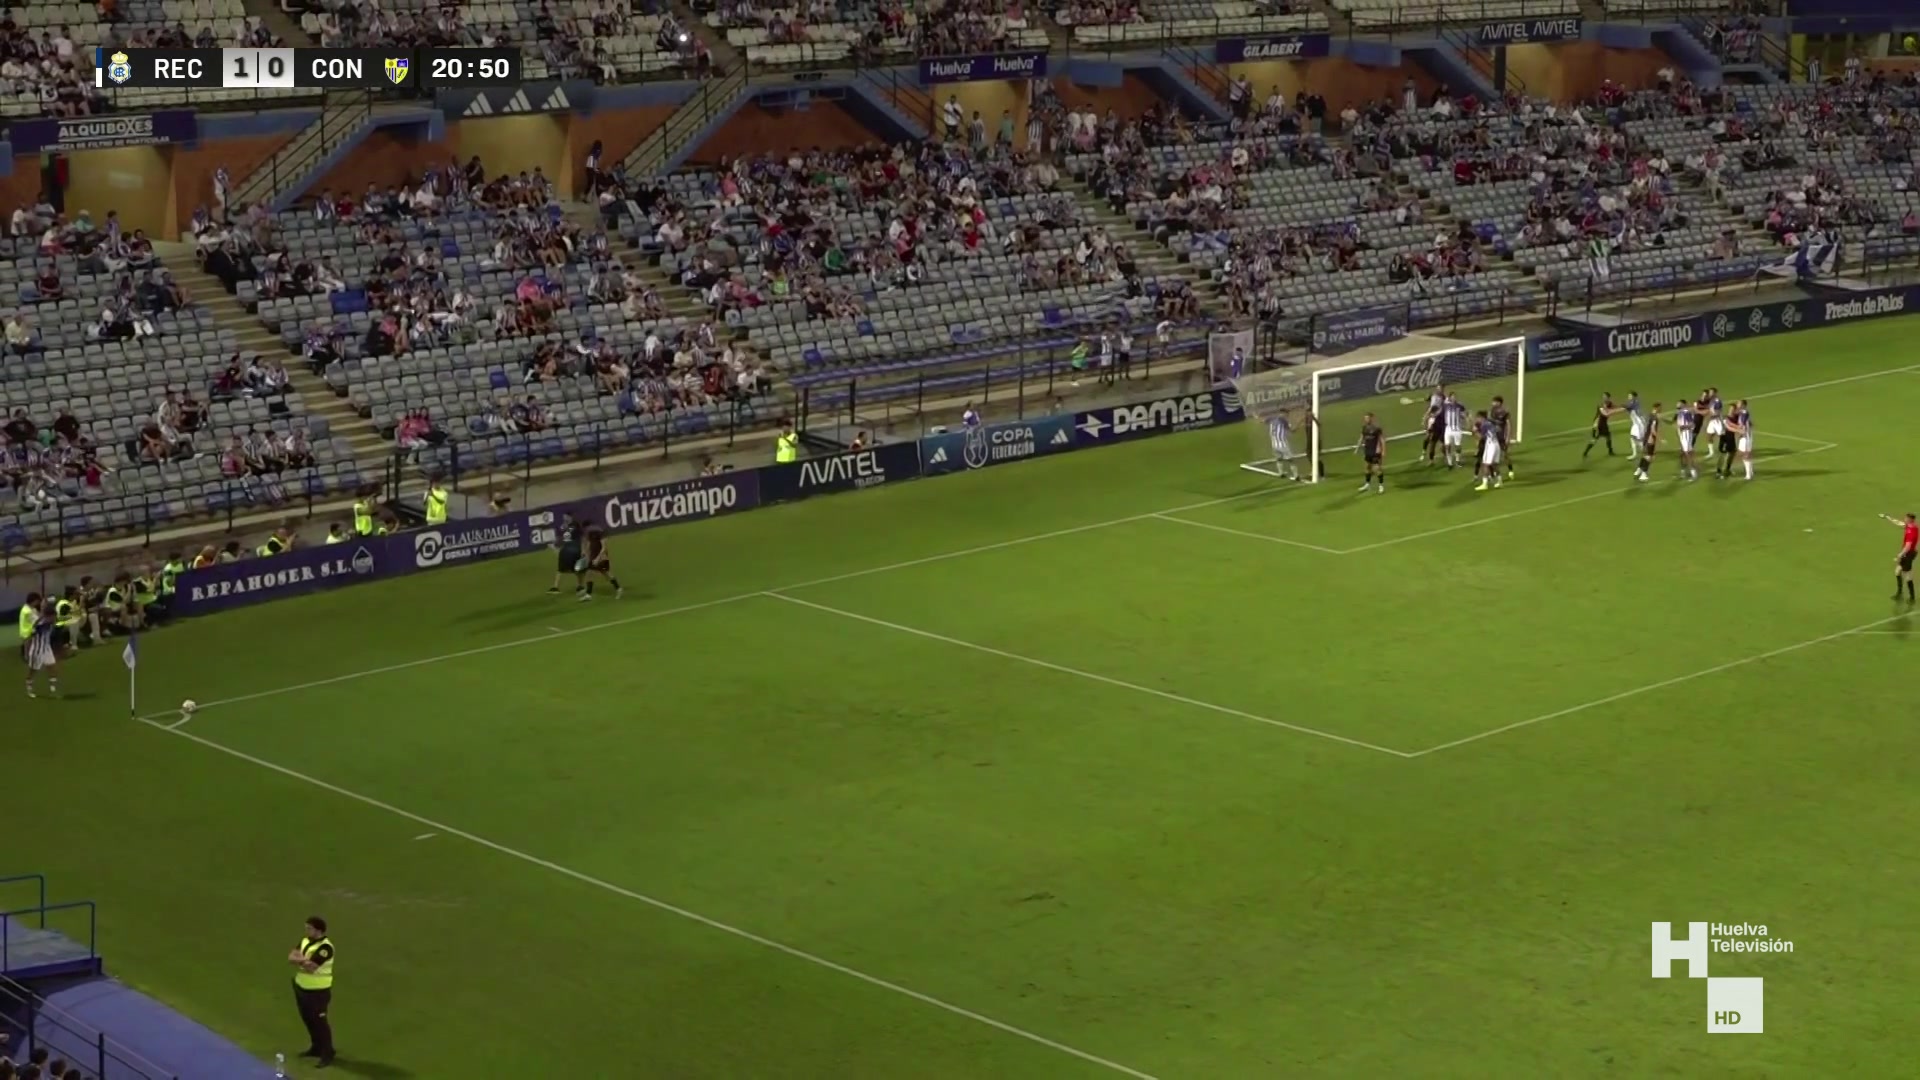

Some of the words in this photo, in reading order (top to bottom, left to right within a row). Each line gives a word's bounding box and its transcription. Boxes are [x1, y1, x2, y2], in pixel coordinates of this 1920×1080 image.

[1482, 24, 1529, 39] AVATEL
[1533, 20, 1579, 35] AVATEL
[1243, 42, 1303, 57] GILABERT
[930, 60, 971, 76] Huelva
[994, 56, 1034, 72] Huelva
[58, 117, 153, 138] ALQUIBOXES
[1825, 299, 1862, 320] Presón
[1863, 298, 1877, 315] de
[1877, 294, 1904, 313] Palos
[1608, 324, 1692, 353] Cruzcampo
[1113, 393, 1213, 434] DAMAS
[992, 427, 1034, 443] COPA
[799, 451, 884, 488] AVATEL
[605, 484, 736, 528] Cruzcampo
[192, 566, 315, 601] REPAHOSER
[321, 558, 352, 577] S.L.
